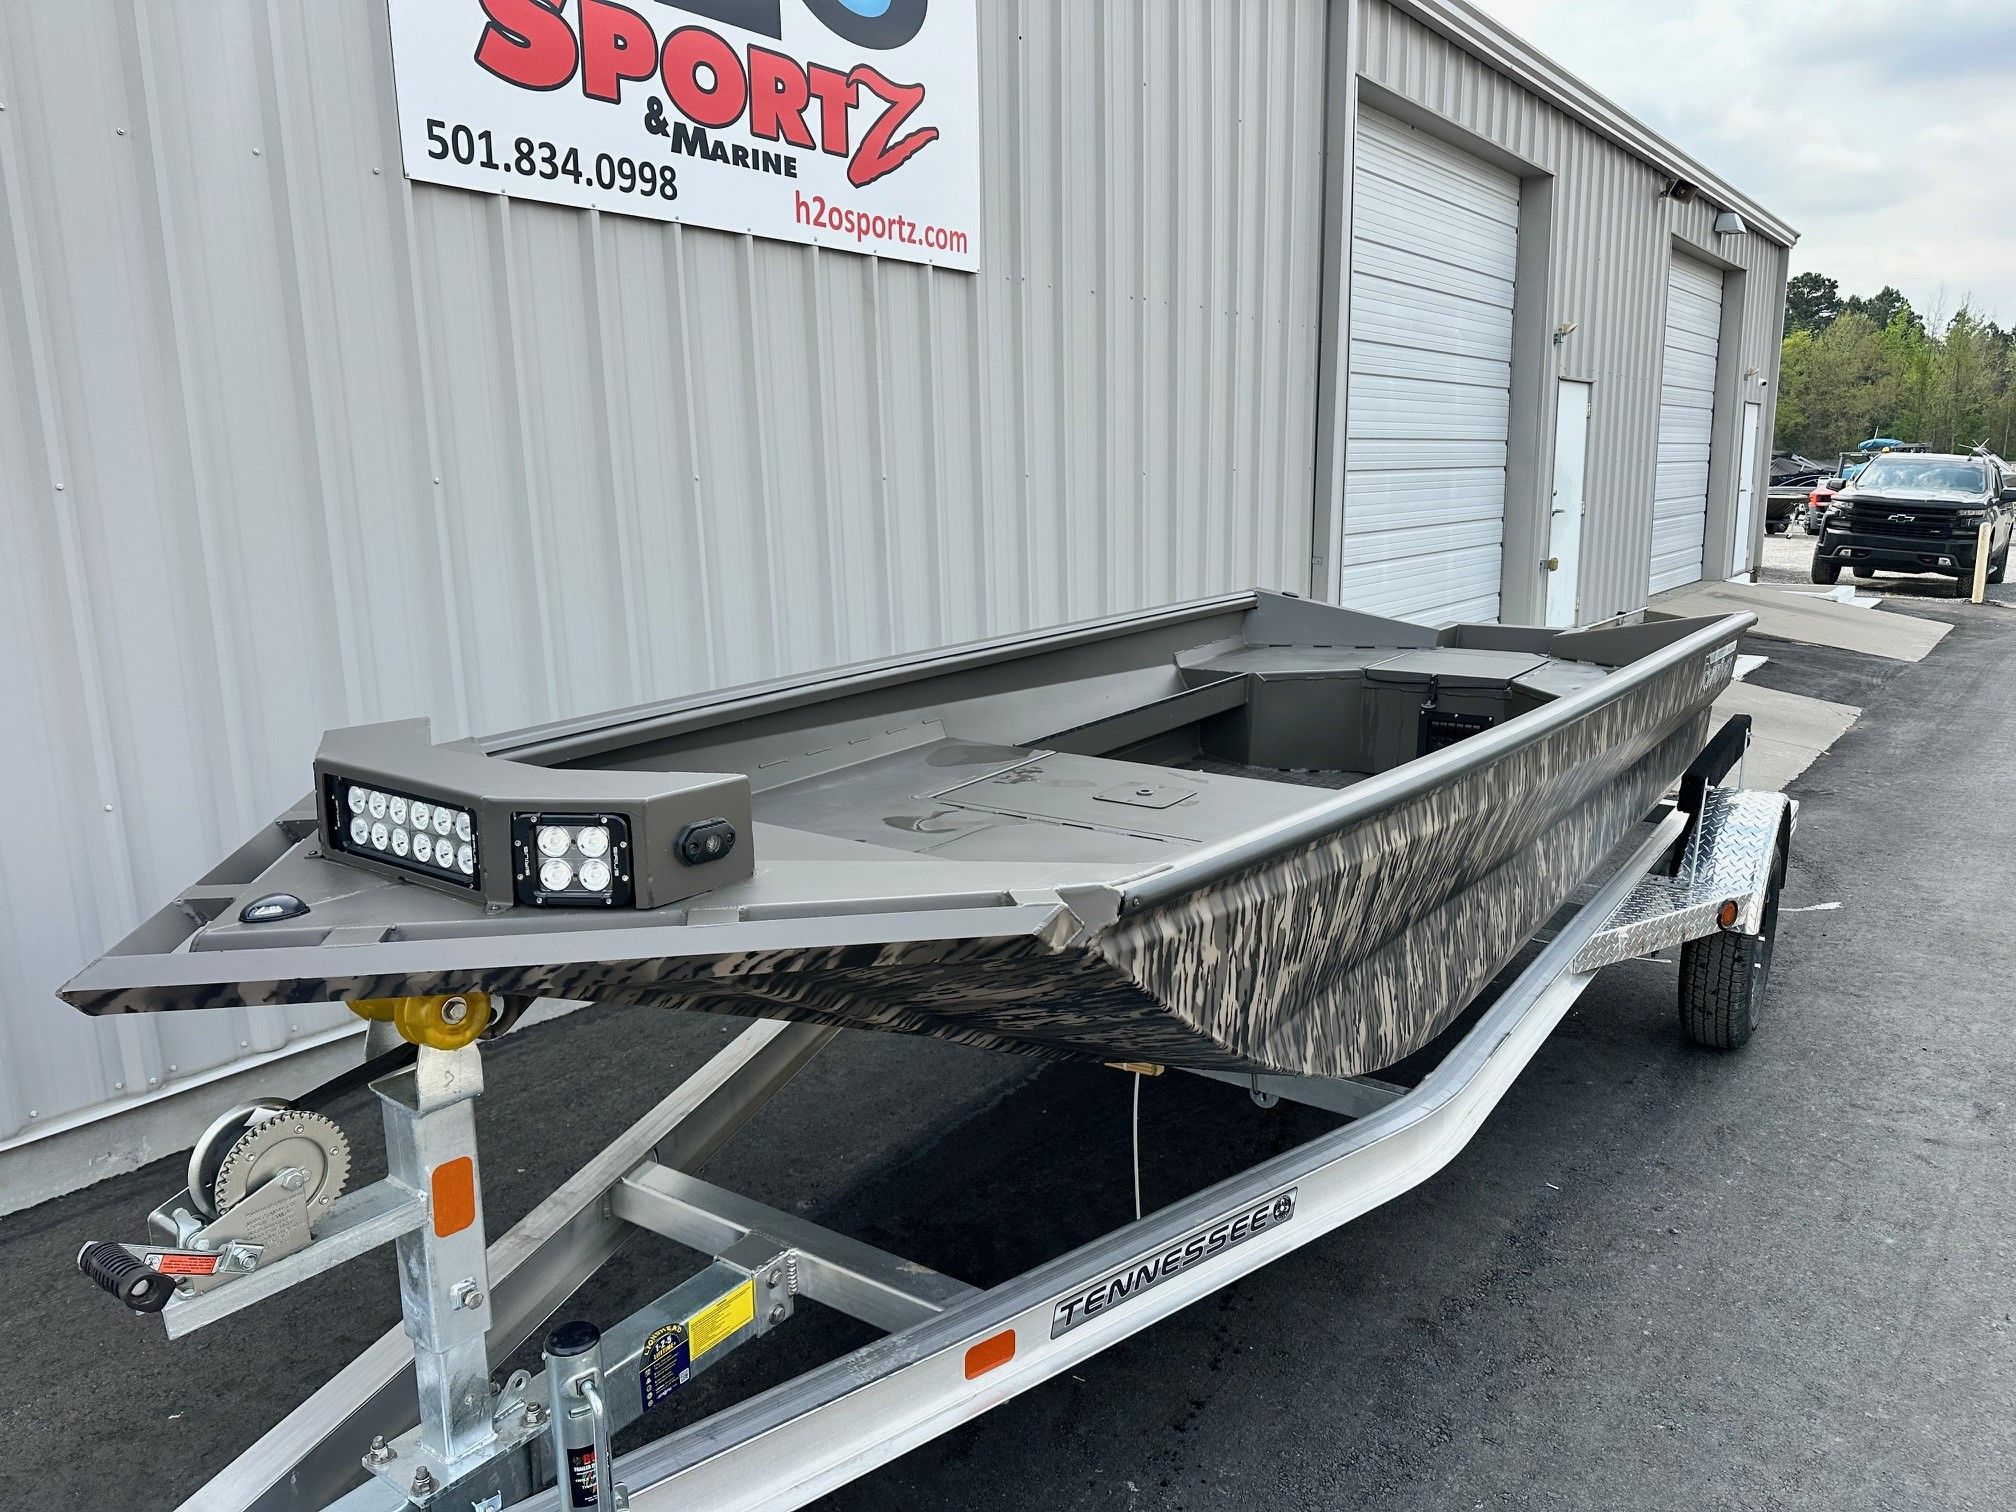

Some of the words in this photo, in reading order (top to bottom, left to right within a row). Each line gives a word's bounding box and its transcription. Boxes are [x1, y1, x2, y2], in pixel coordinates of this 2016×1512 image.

[426, 119, 678, 201] 501.834.0998
[644, 96, 670, 136] &
[671, 122, 798, 179] MARINE
[795, 190, 968, 255] h2osportz.com
[1060, 1205, 1270, 1327] TENNESSEE
